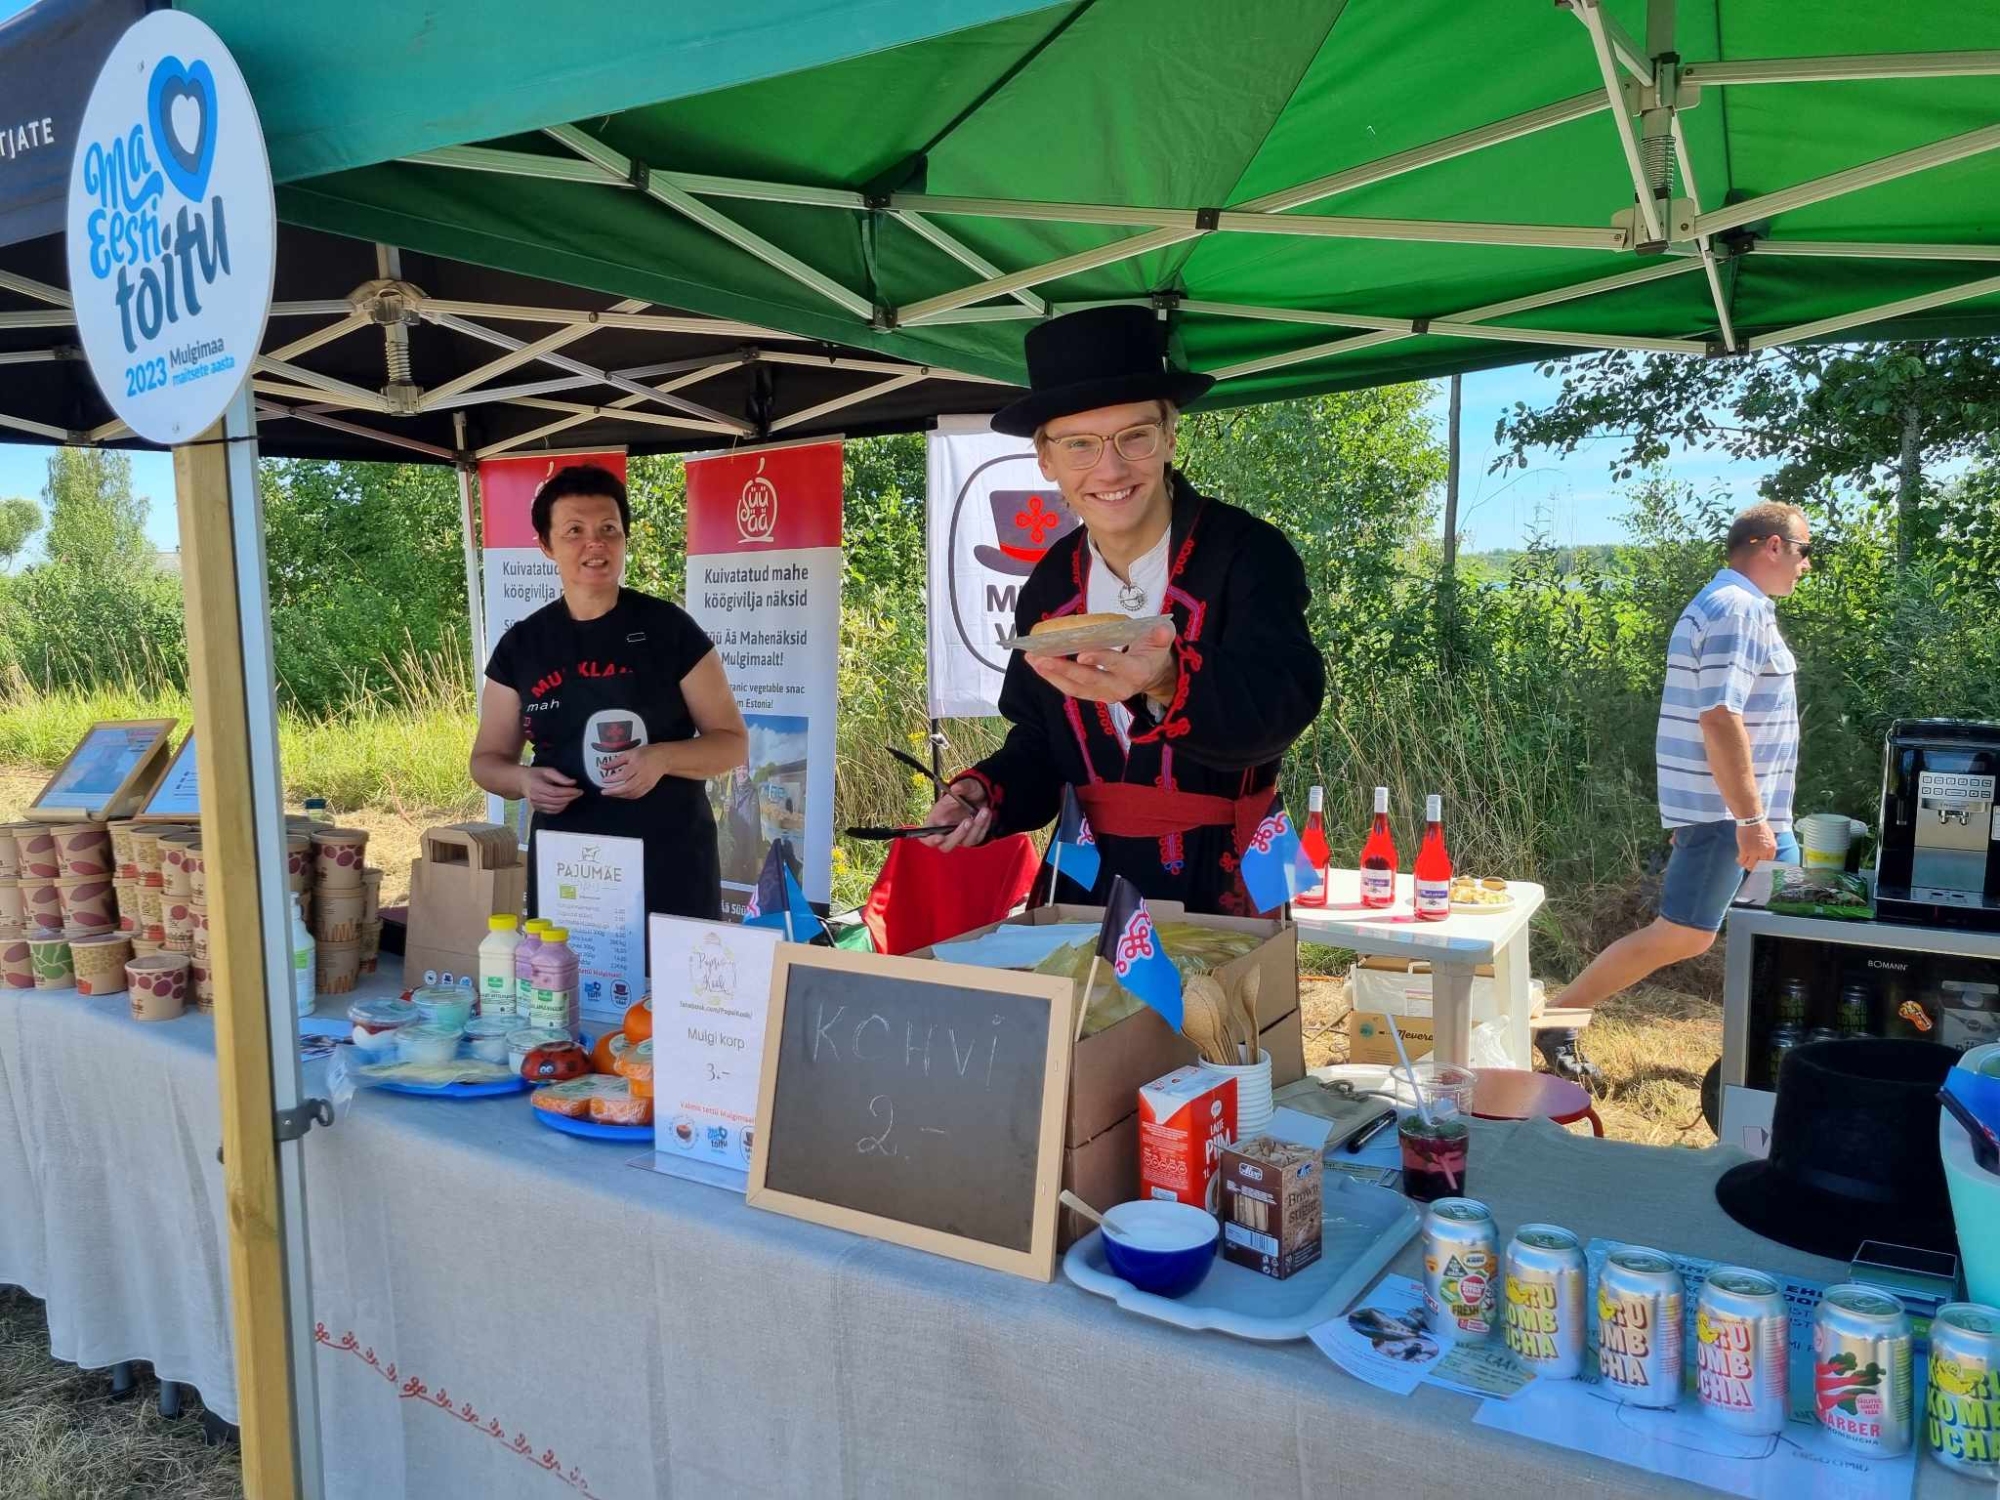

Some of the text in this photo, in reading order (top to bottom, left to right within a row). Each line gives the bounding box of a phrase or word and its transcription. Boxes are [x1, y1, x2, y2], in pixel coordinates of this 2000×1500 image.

[88, 197, 163, 279] Eesti
[116, 195, 231, 354] toitu
[126, 337, 225, 397] 2023 Mulgimaa
[704, 563, 809, 584] Kuivatatud mahe
[504, 583, 556, 602] köögivilja
[704, 589, 808, 612] köögivilja näksid
[740, 630, 808, 645] Mahenäksid
[721, 651, 784, 669] Mulgimaalt!
[531, 668, 565, 698] MU
[729, 683, 748, 692] anic
[750, 683, 784, 694] vegetable
[1868, 960, 1906, 971] BOMANN
[688, 1027, 745, 1051] Mulgi korp
[1452, 1304, 1480, 1317] FRESH
